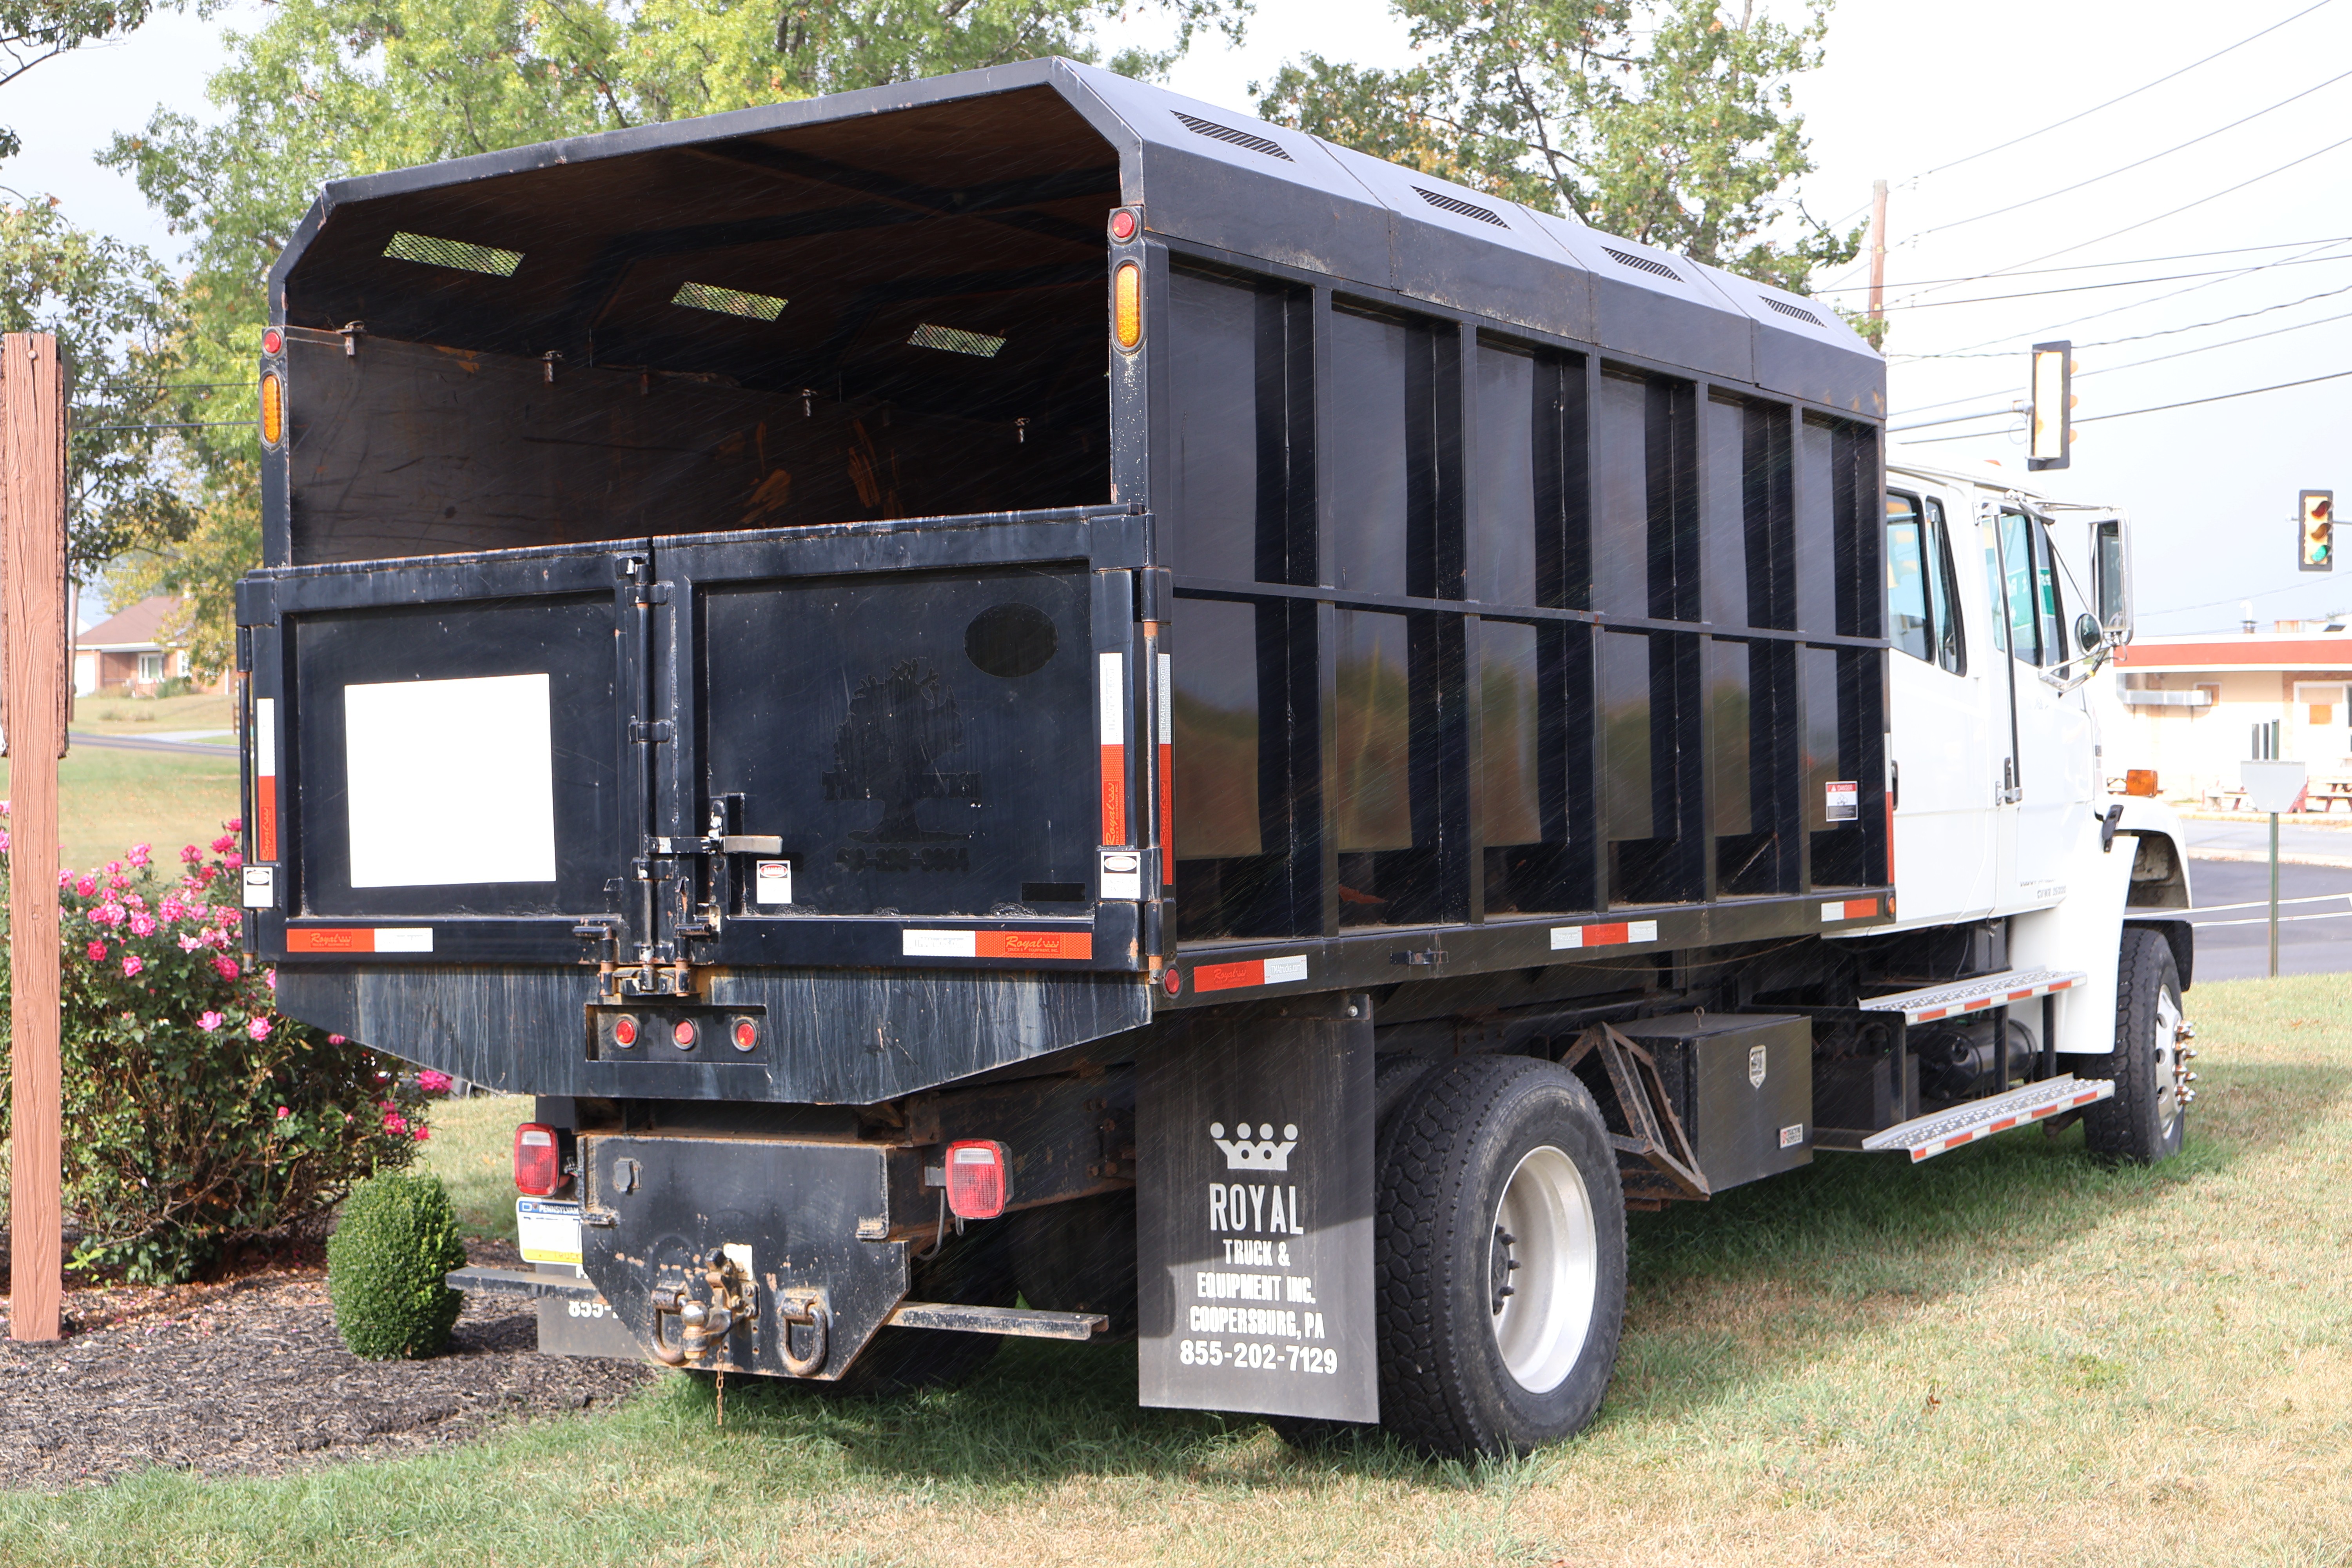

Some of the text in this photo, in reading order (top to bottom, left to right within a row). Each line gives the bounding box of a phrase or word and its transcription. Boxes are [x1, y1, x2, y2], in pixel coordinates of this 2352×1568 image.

[1106, 803, 1118, 846] Royal
[1006, 936, 1043, 950] Royal
[1214, 967, 1236, 981] Royal
[1271, 964, 1301, 974] TMAtrucks.com
[1210, 1183, 1303, 1235] ROYAL
[1223, 1240, 1291, 1267] TRUCK &
[1197, 1272, 1316, 1304] EQUIPMENT INC.
[568, 1300, 619, 1319] 855-
[1190, 1306, 1325, 1340] COOPERSBURG, PA
[1180, 1340, 1338, 1374] 855-202-7129
